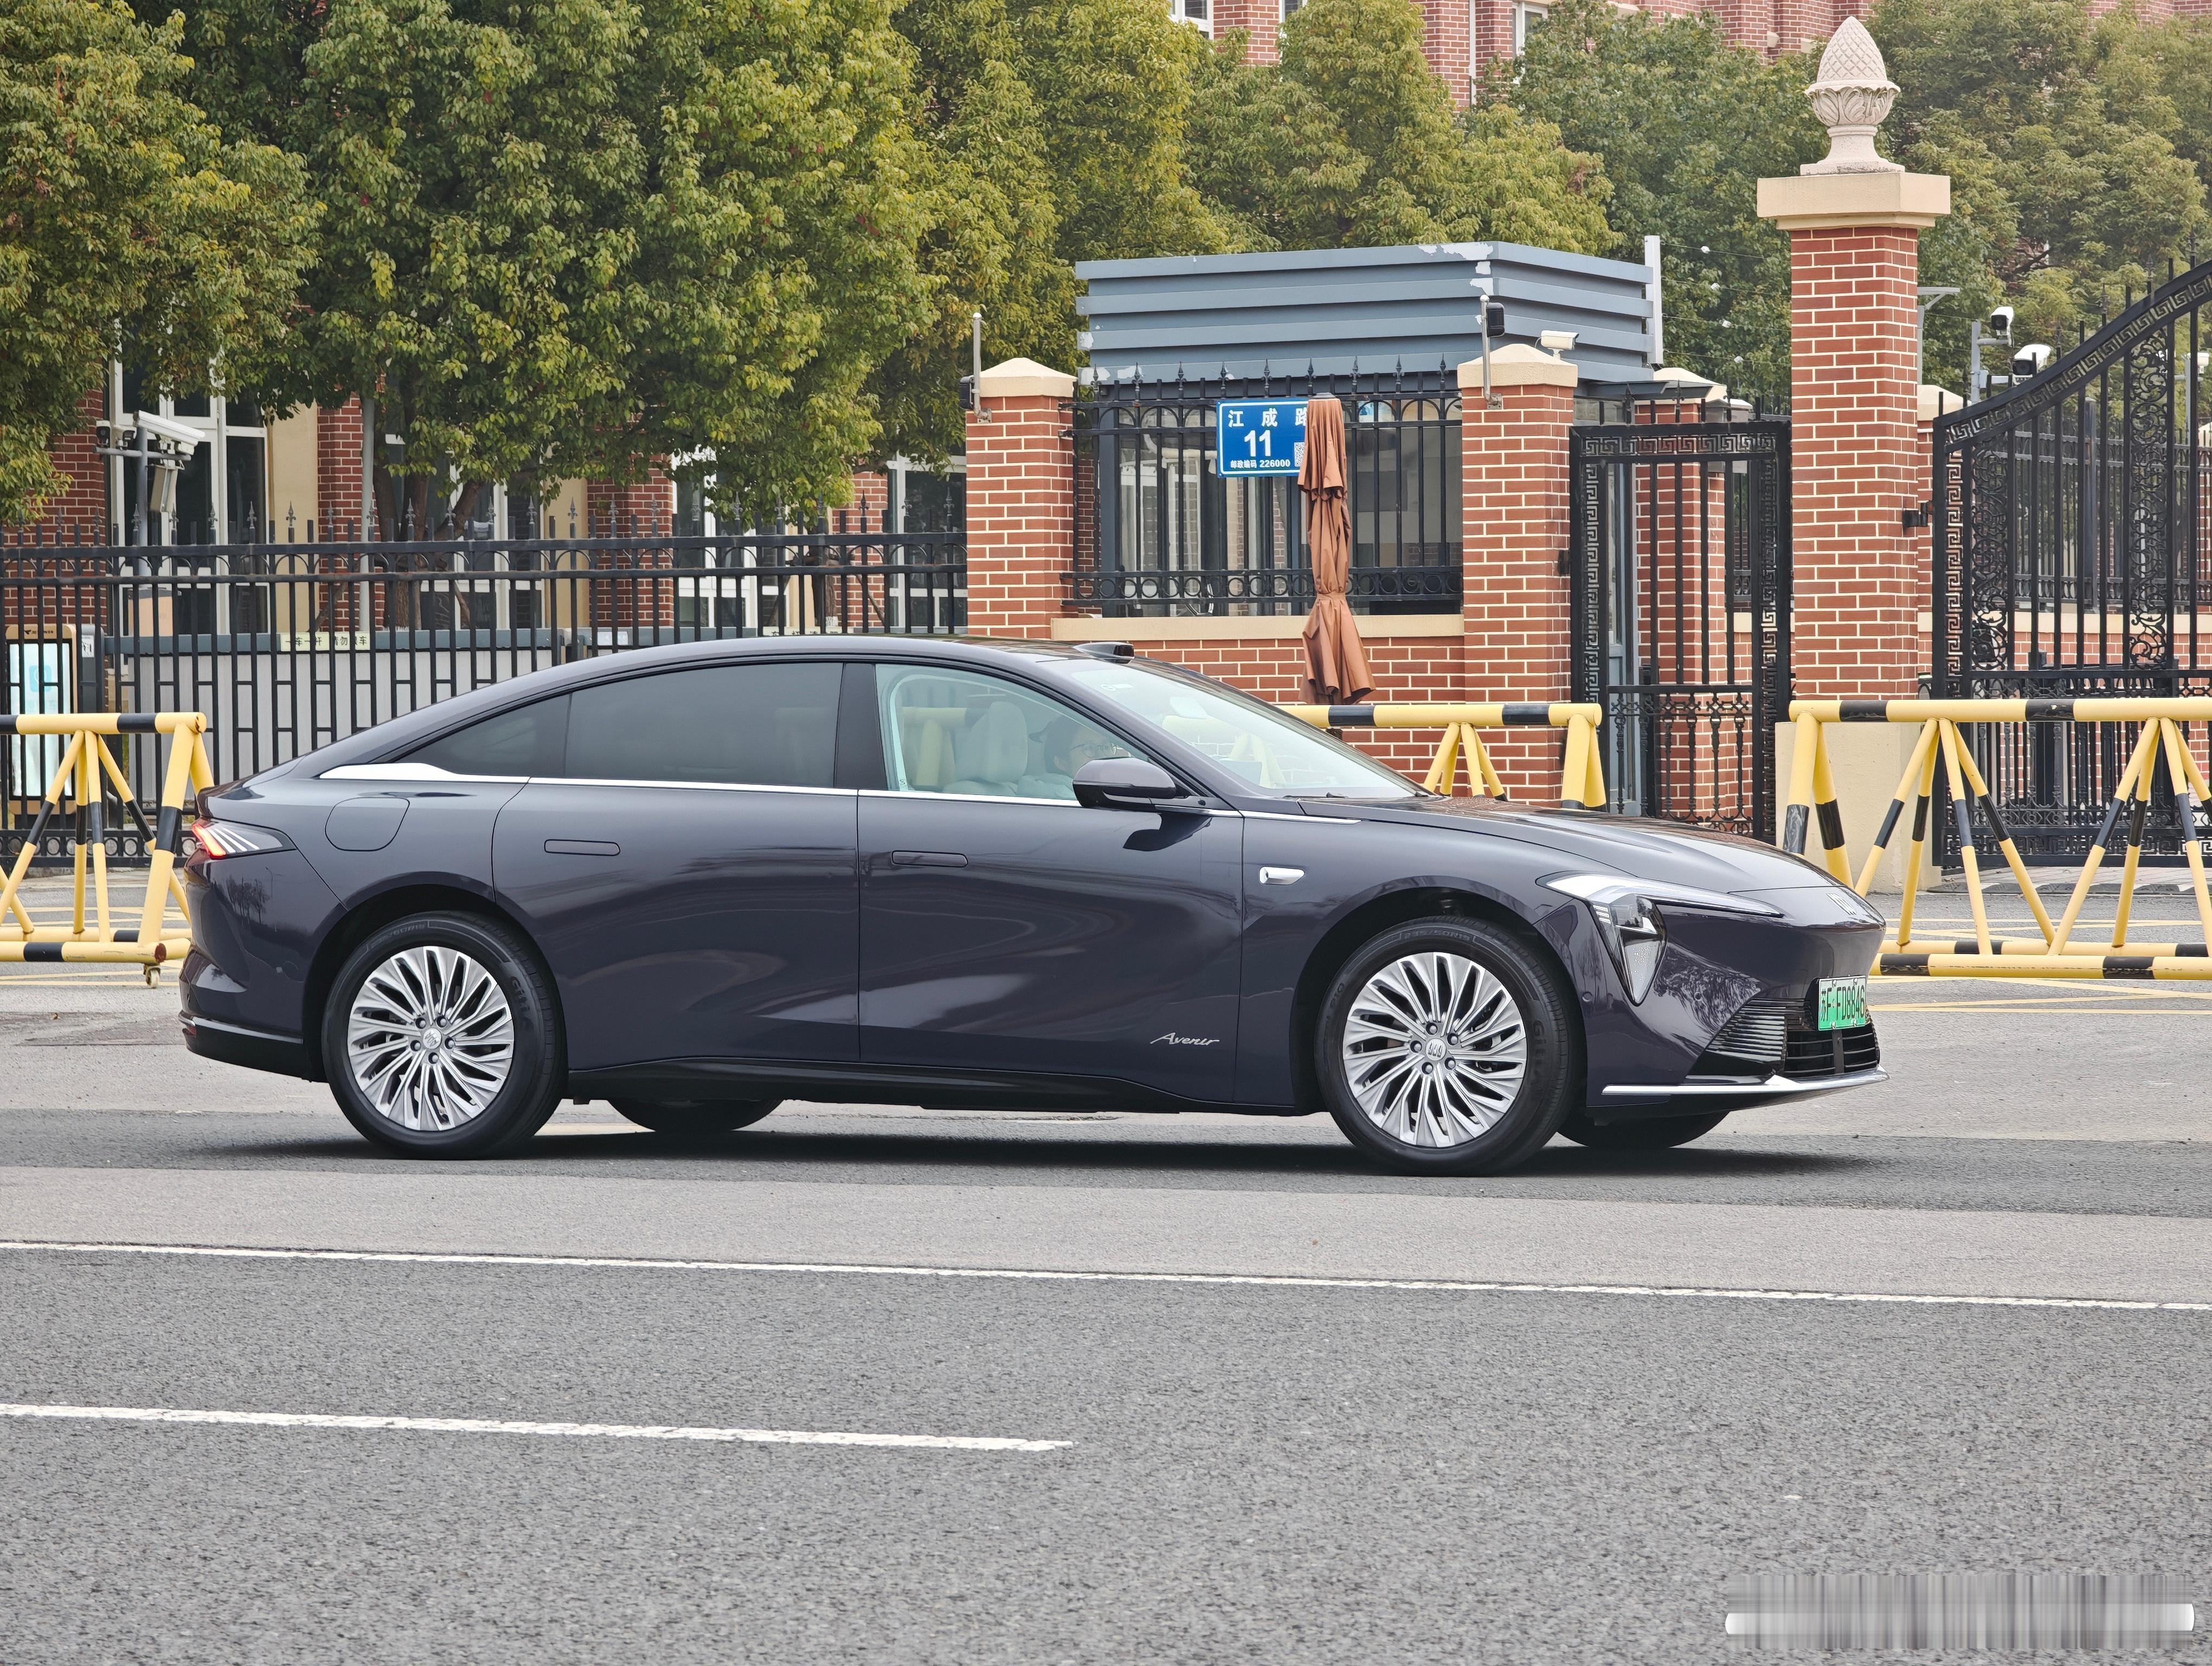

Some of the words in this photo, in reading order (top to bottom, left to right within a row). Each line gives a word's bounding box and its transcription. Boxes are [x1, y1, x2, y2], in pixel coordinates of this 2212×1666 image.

[1244, 430, 1271, 457] 11
[1230, 460, 1257, 469] 邮政编码
[1259, 459, 1290, 468] 226000
[1150, 1032, 1220, 1046] Avenir
